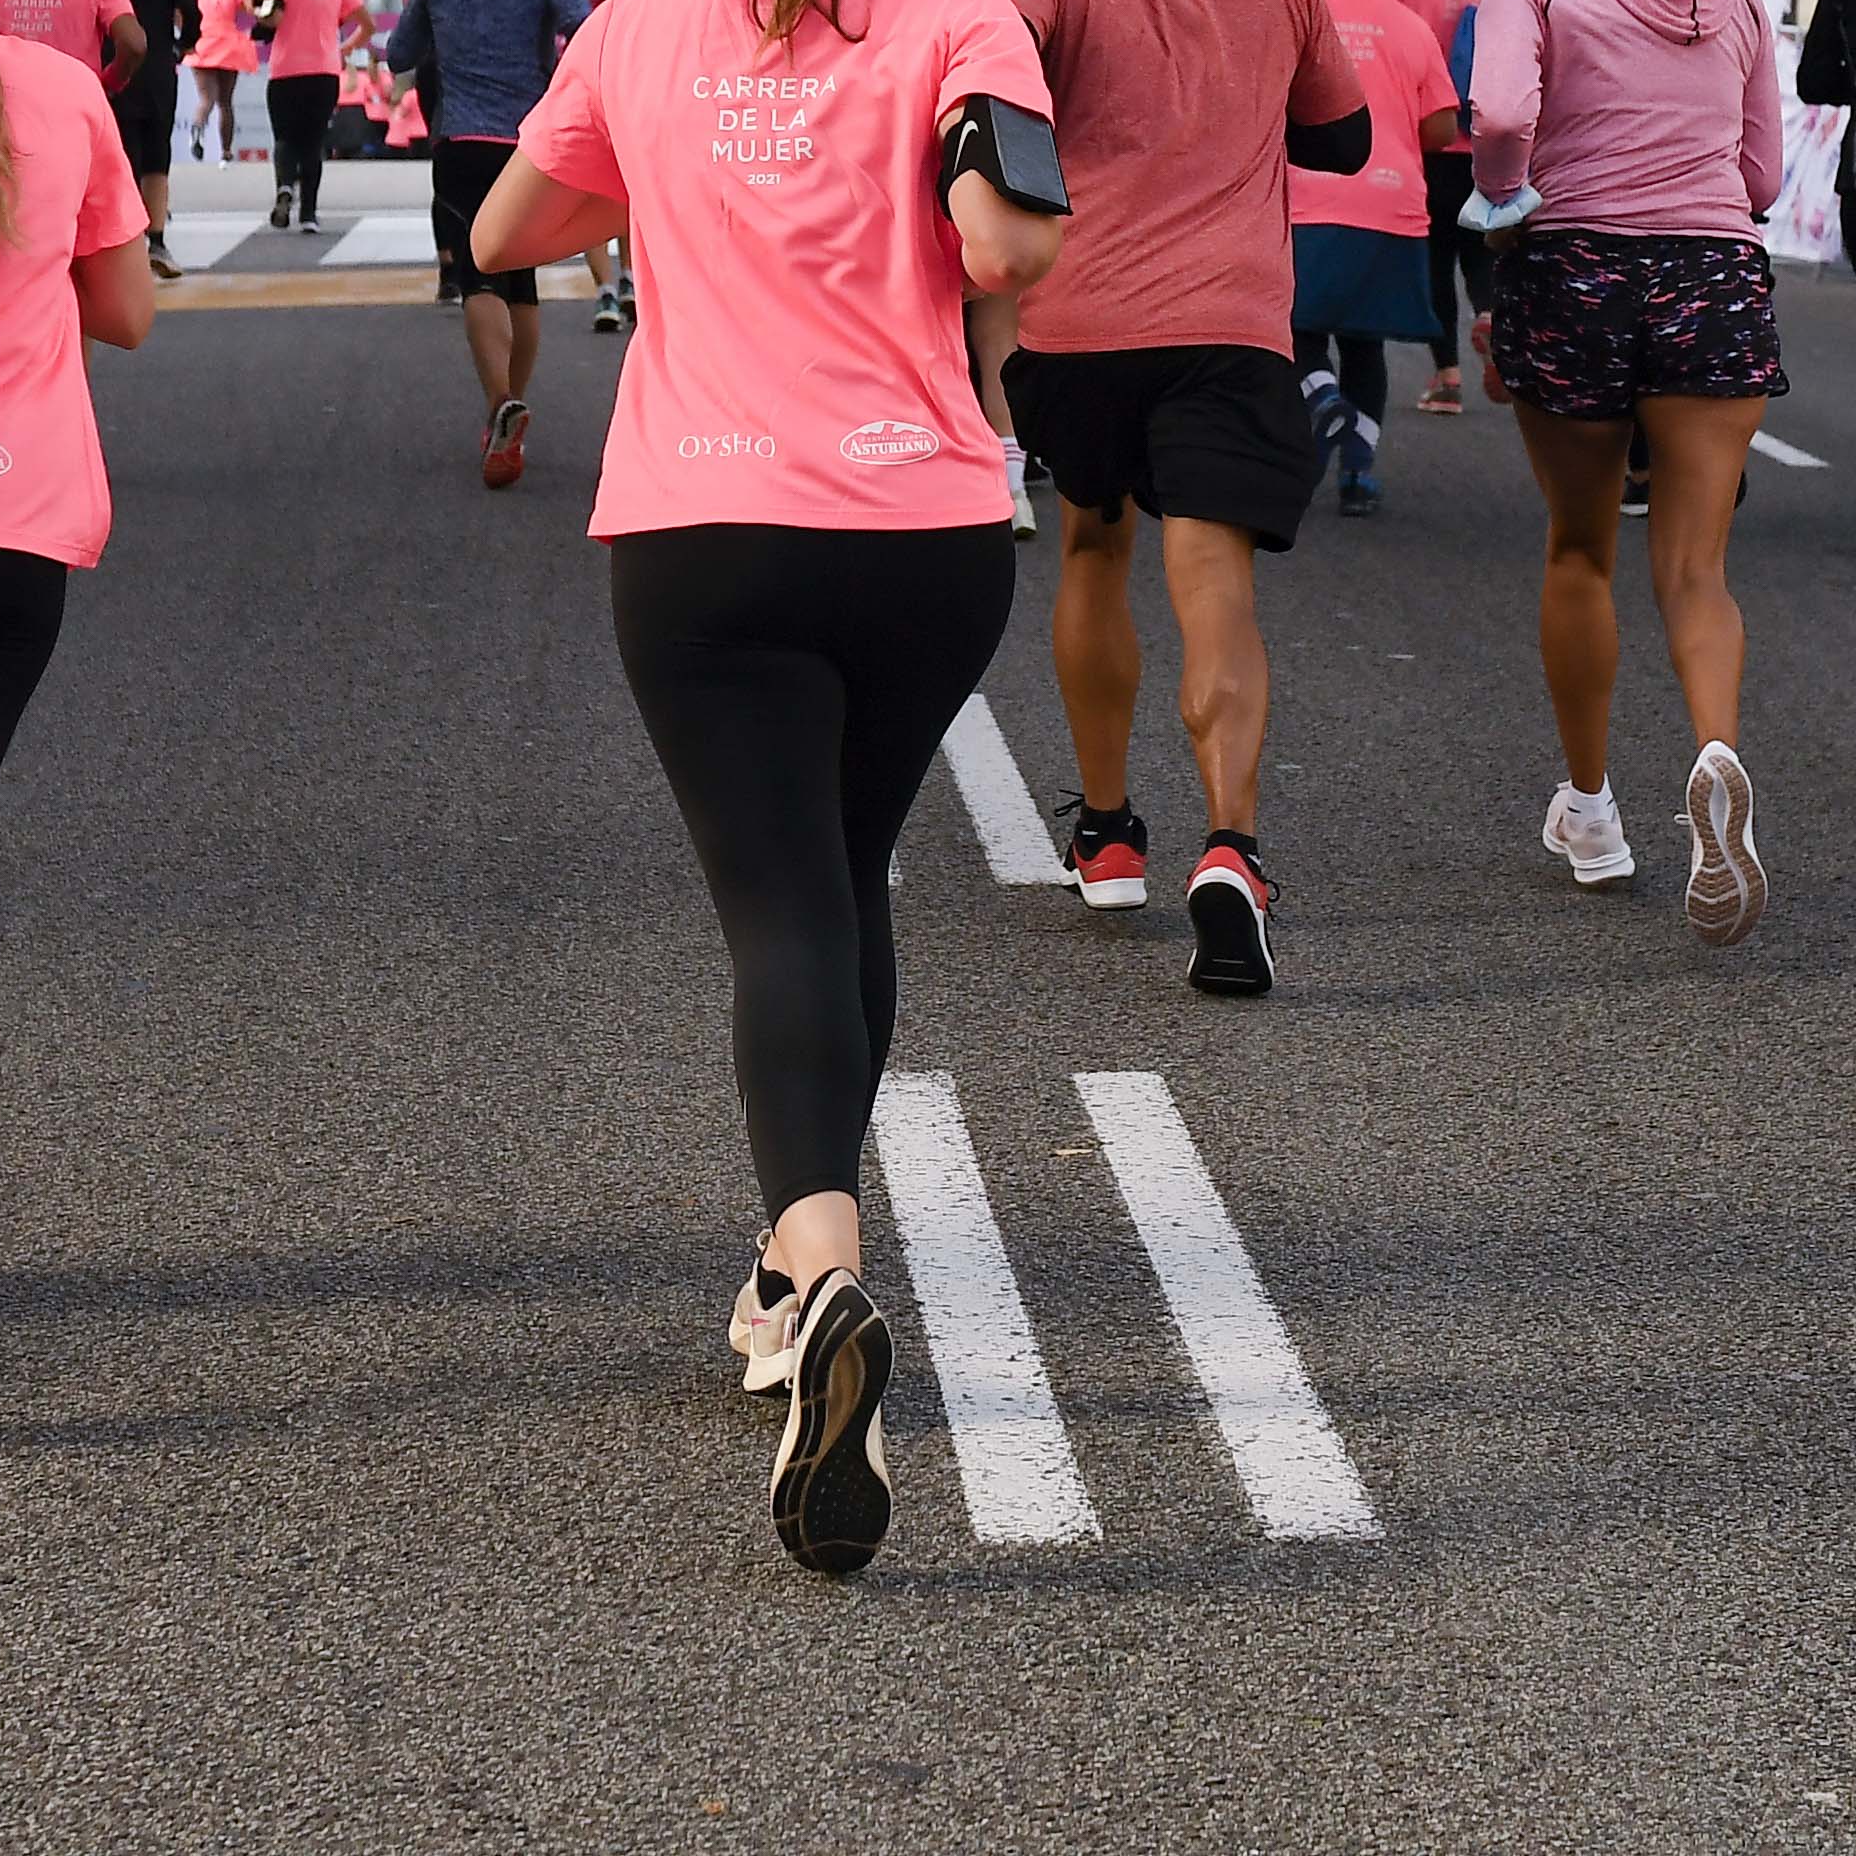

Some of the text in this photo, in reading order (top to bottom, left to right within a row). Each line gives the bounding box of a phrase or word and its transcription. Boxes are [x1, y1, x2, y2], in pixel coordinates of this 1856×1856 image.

[693, 75, 837, 99] CARRERA
[718, 108, 807, 131] DE LA
[712, 137, 815, 162] MUJER
[747, 173, 781, 185] 2021
[678, 432, 777, 459] OYSHO
